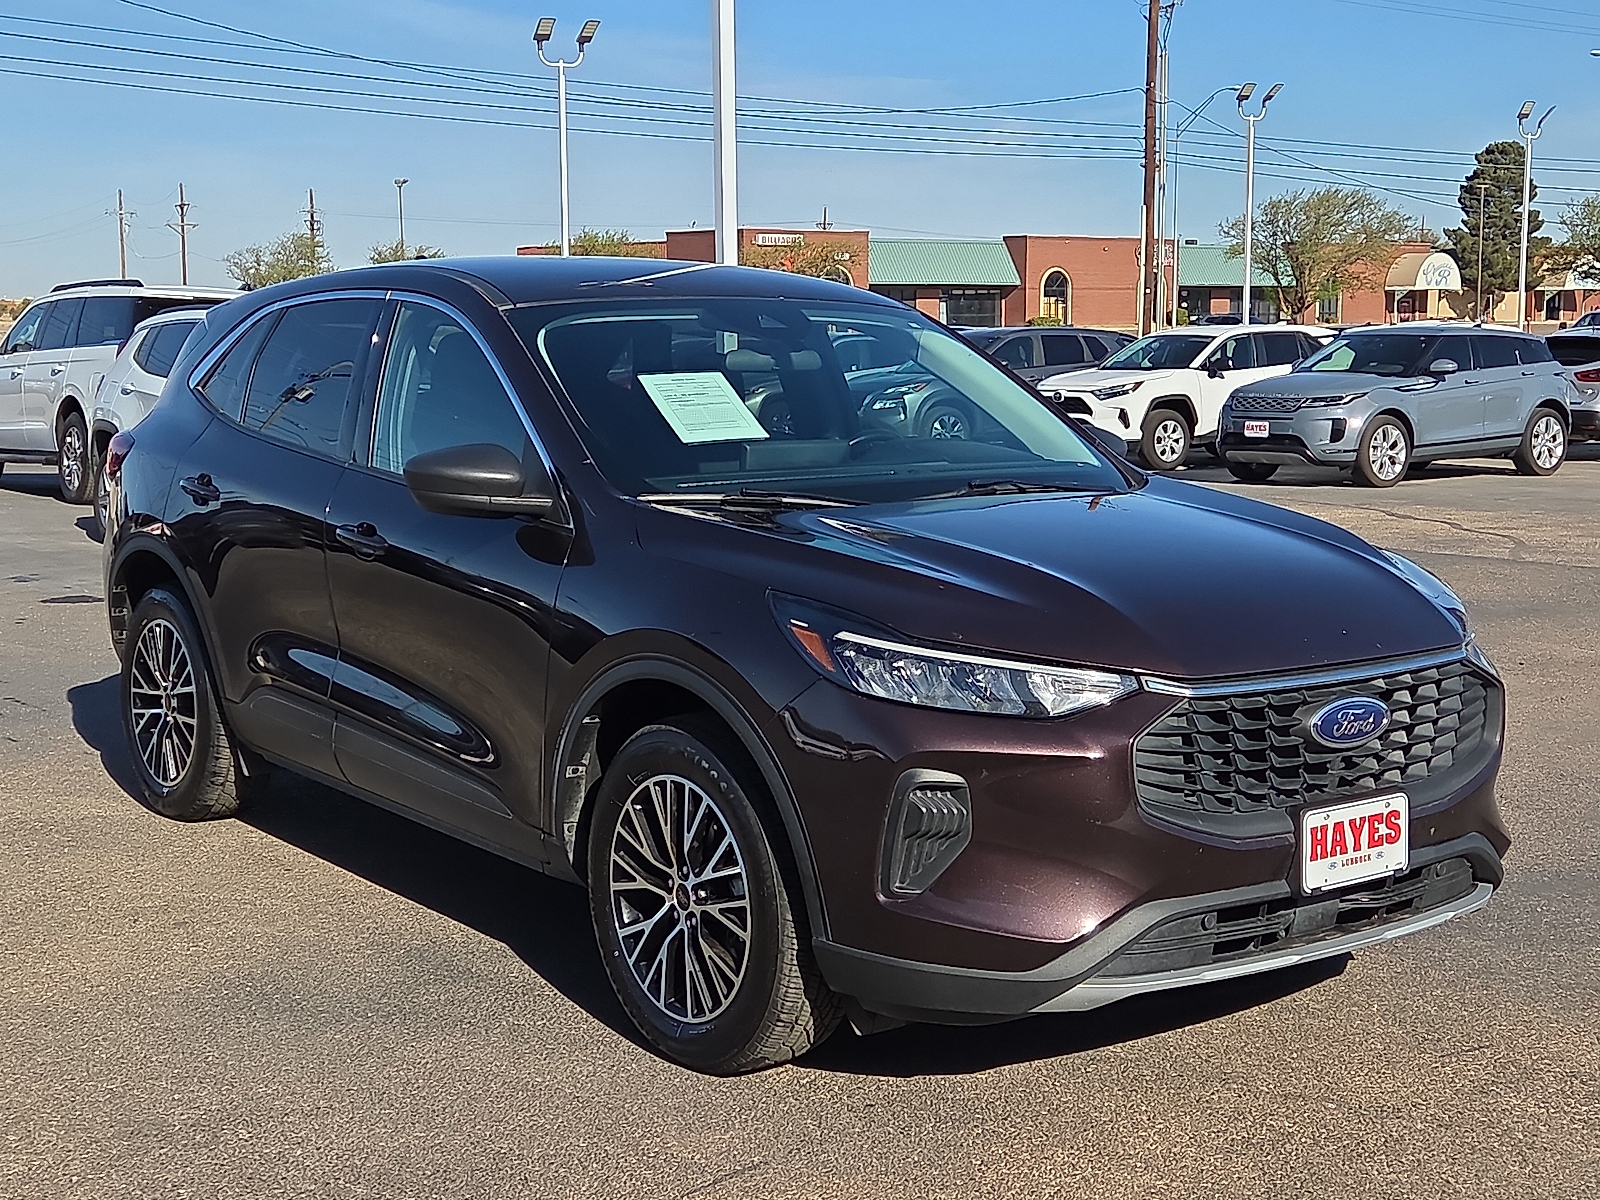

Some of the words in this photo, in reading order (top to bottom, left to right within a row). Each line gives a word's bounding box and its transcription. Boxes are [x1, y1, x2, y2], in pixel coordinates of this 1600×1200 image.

[1333, 708, 1375, 737] Ford
[1309, 809, 1402, 862] HAYES
[1341, 853, 1372, 867] LUBBOCK
